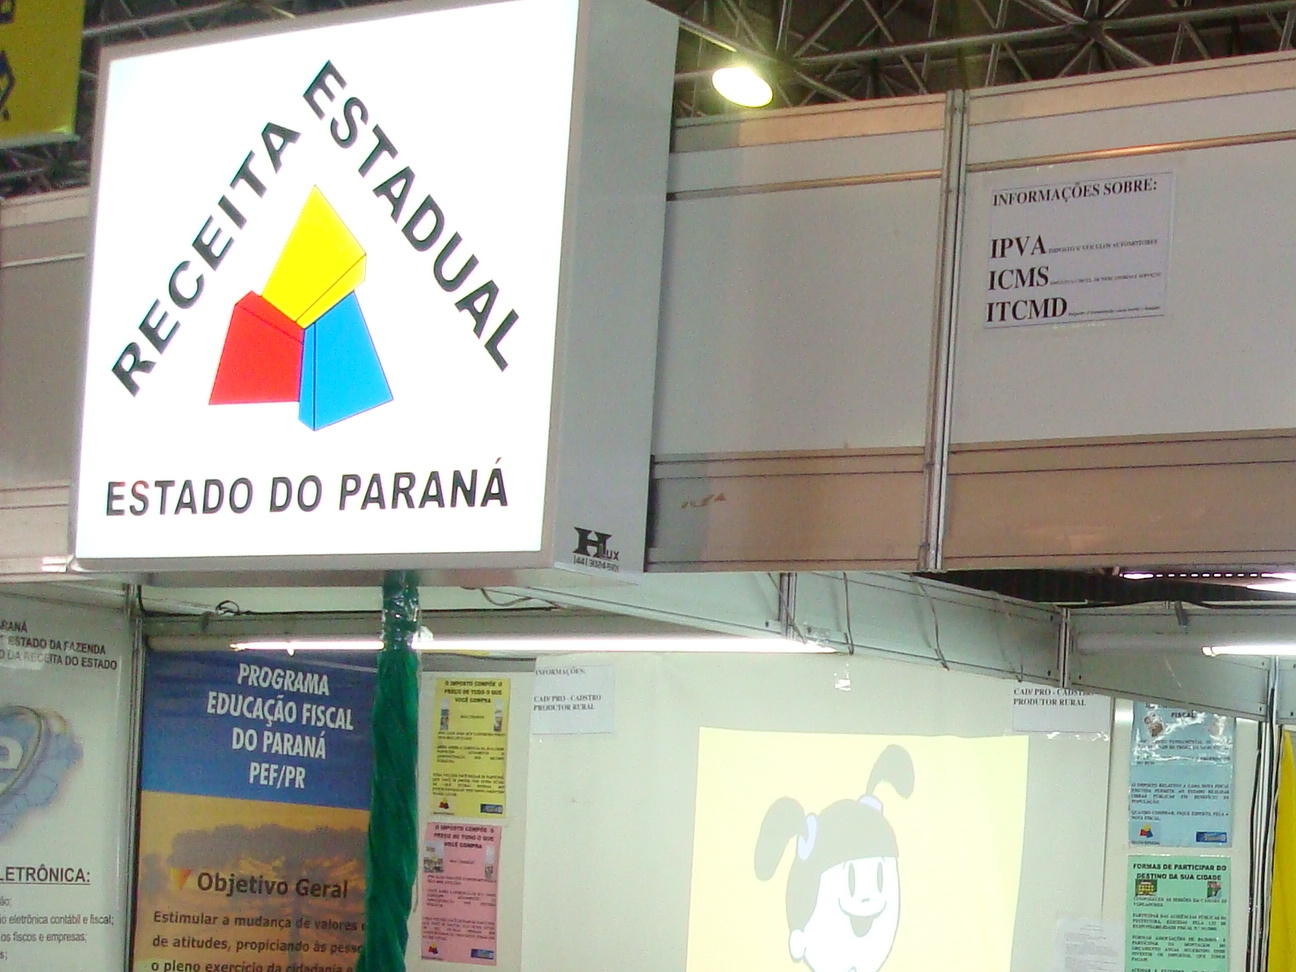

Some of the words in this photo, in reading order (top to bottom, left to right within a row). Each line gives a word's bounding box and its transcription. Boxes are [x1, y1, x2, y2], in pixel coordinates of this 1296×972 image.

[993, 182, 1099, 207] INFORMAÇÕES
[1103, 178, 1157, 195] SOBRE:
[111, 122, 302, 396] RECEITA
[302, 60, 519, 371] ESTADUAL
[990, 235, 1047, 259] IPVA
[988, 265, 1049, 291] ICMS
[986, 296, 1067, 322] ITCMD
[106, 477, 253, 516] ESTADO
[270, 475, 322, 512] DO
[339, 458, 508, 510] PARANÁ
[8, 636, 47, 648] ESTADO
[50, 640, 62, 650] DA
[64, 642, 106, 654] FAZENDA
[64, 656, 78, 666] DO
[82, 657, 118, 670] ESTADO
[237, 662, 330, 696] PROGRAMA
[207, 691, 297, 727] EDUCAÇÃO
[302, 703, 354, 730] FISCAL
[232, 727, 257, 750] DO
[263, 731, 326, 759] PARANÁ
[249, 762, 306, 789] PEF/PR
[0, 864, 90, 883] ETRÔNICA:
[197, 872, 288, 897] Objetivo
[295, 878, 348, 898] Geral
[9, 914, 48, 925] eletrônica
[50, 914, 82, 925] contábil
[82, 917, 88, 925] e
[90, 914, 114, 926] fiscal;
[154, 911, 218, 925] Estimular
[222, 916, 230, 926] a
[234, 915, 291, 931] mudança
[296, 916, 311, 929] de
[314, 918, 358, 931] valores
[13, 932, 37, 942] fiscos
[38, 934, 44, 942] e
[46, 933, 87, 944] empresas;
[152, 935, 169, 948] de
[173, 936, 231, 950] atitudes,
[236, 939, 310, 953] propiciando
[312, 942, 327, 953] às
[152, 962, 159, 972] o
